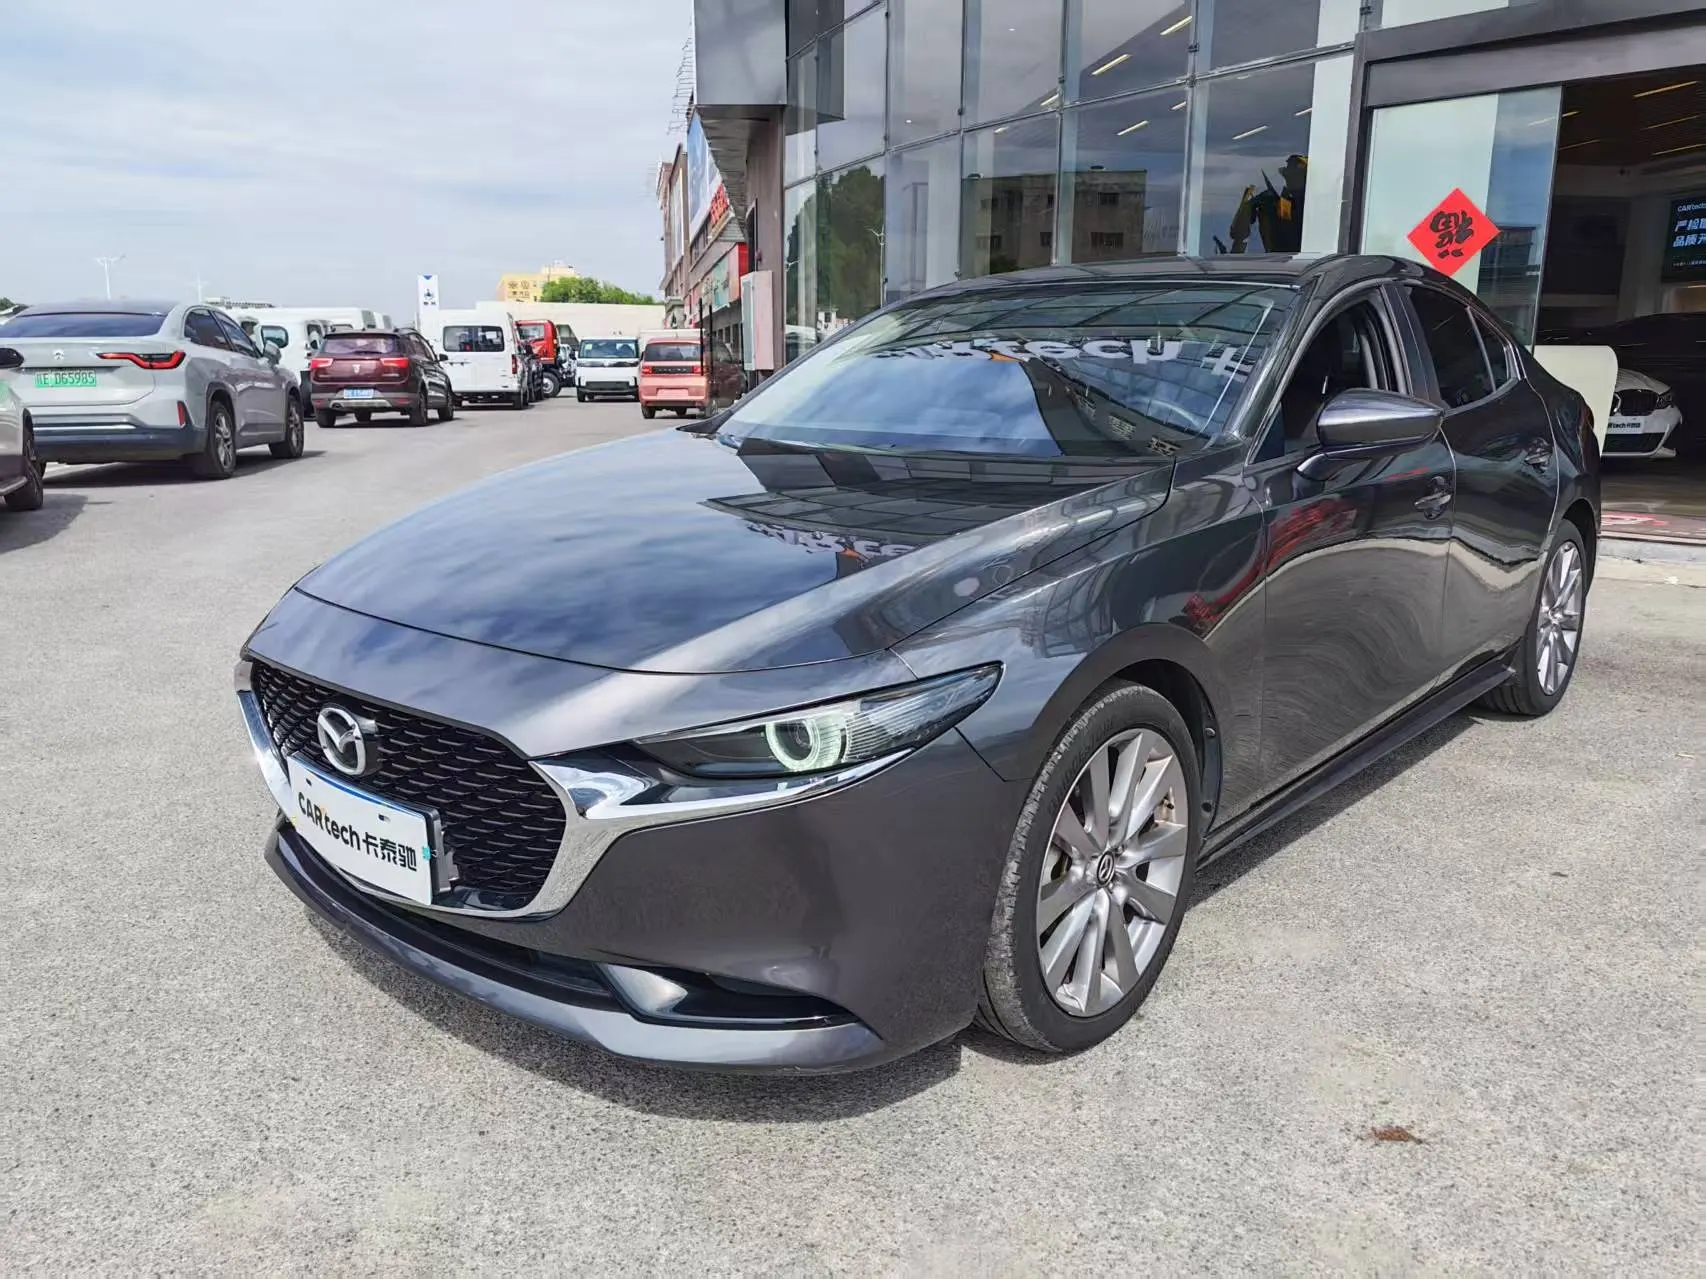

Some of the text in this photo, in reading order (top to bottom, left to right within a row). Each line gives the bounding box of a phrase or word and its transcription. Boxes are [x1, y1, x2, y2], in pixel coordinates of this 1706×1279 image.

[298, 791, 417, 872] CARtech 卡泰驰
